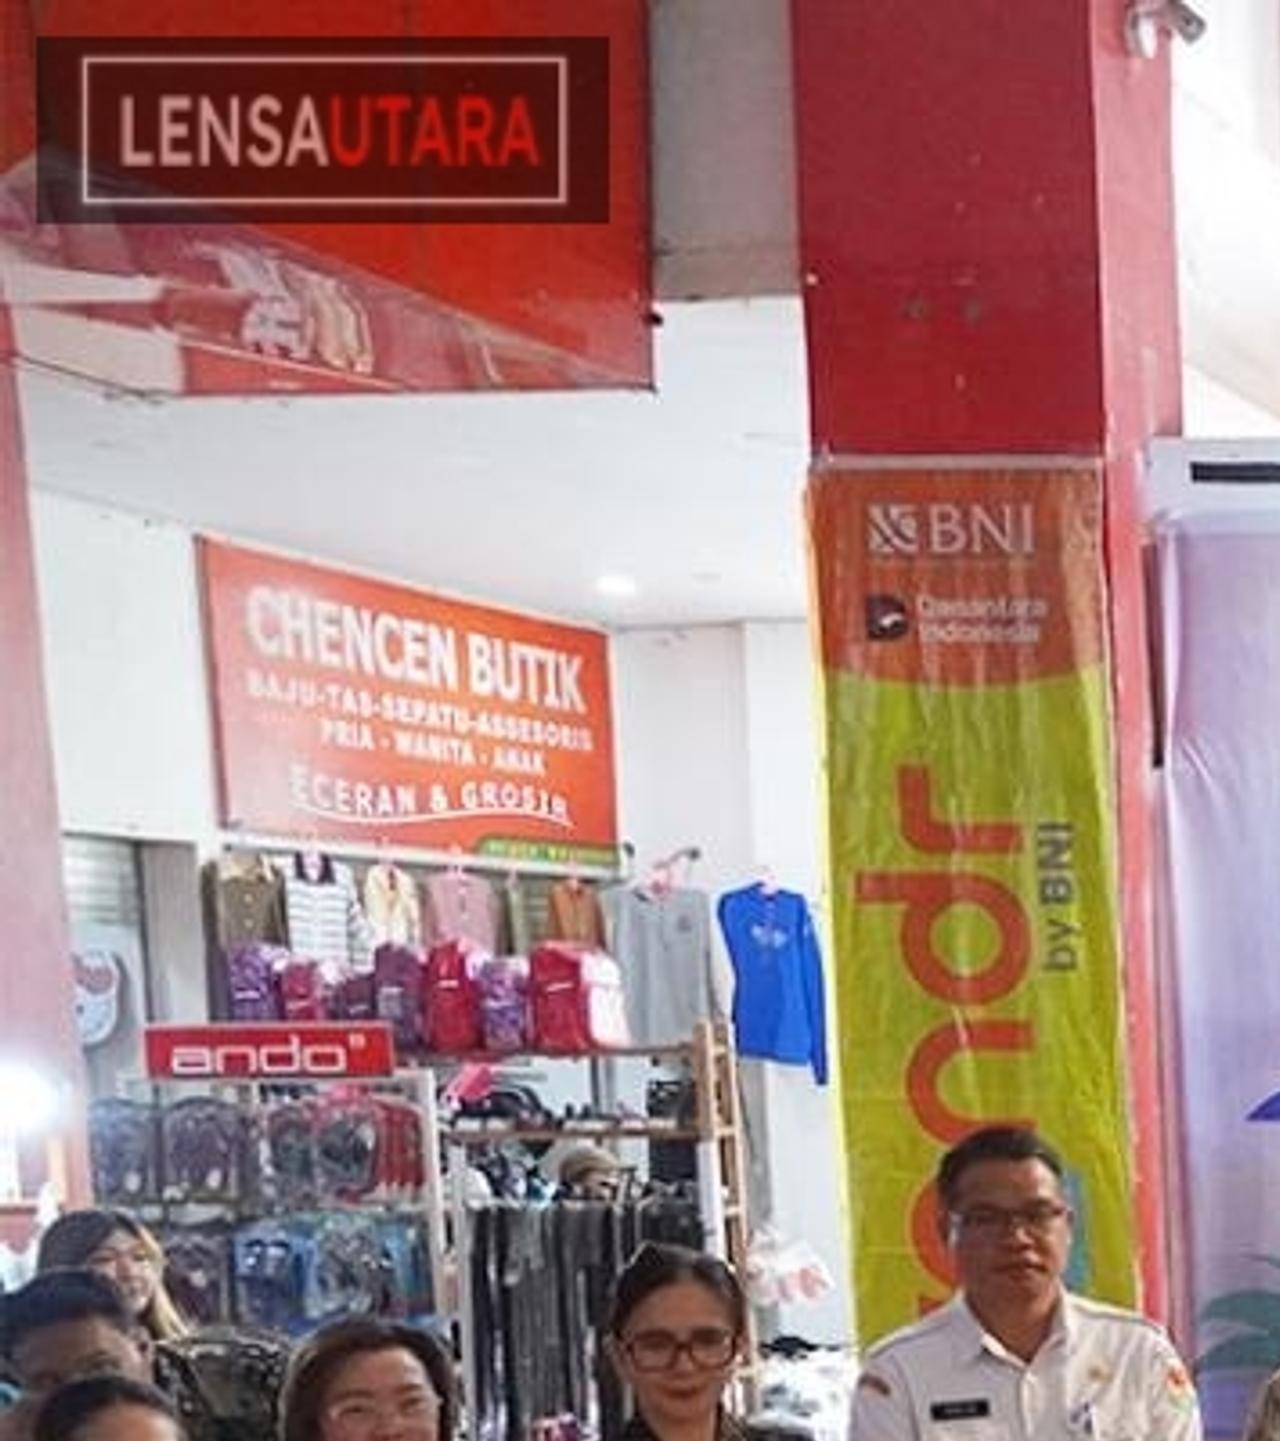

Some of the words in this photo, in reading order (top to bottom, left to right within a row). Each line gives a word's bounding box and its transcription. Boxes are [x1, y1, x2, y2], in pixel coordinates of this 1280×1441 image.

[929, 504, 1035, 552] BNI
[245, 585, 459, 692] CHENCEN
[466, 630, 587, 714] BUTIK
[290, 763, 416, 816] ECERAN
[1038, 822, 1074, 905] BNI
[1043, 908, 1084, 971] by
[171, 1034, 348, 1075] ando
[855, 762, 1037, 1318] ndr
